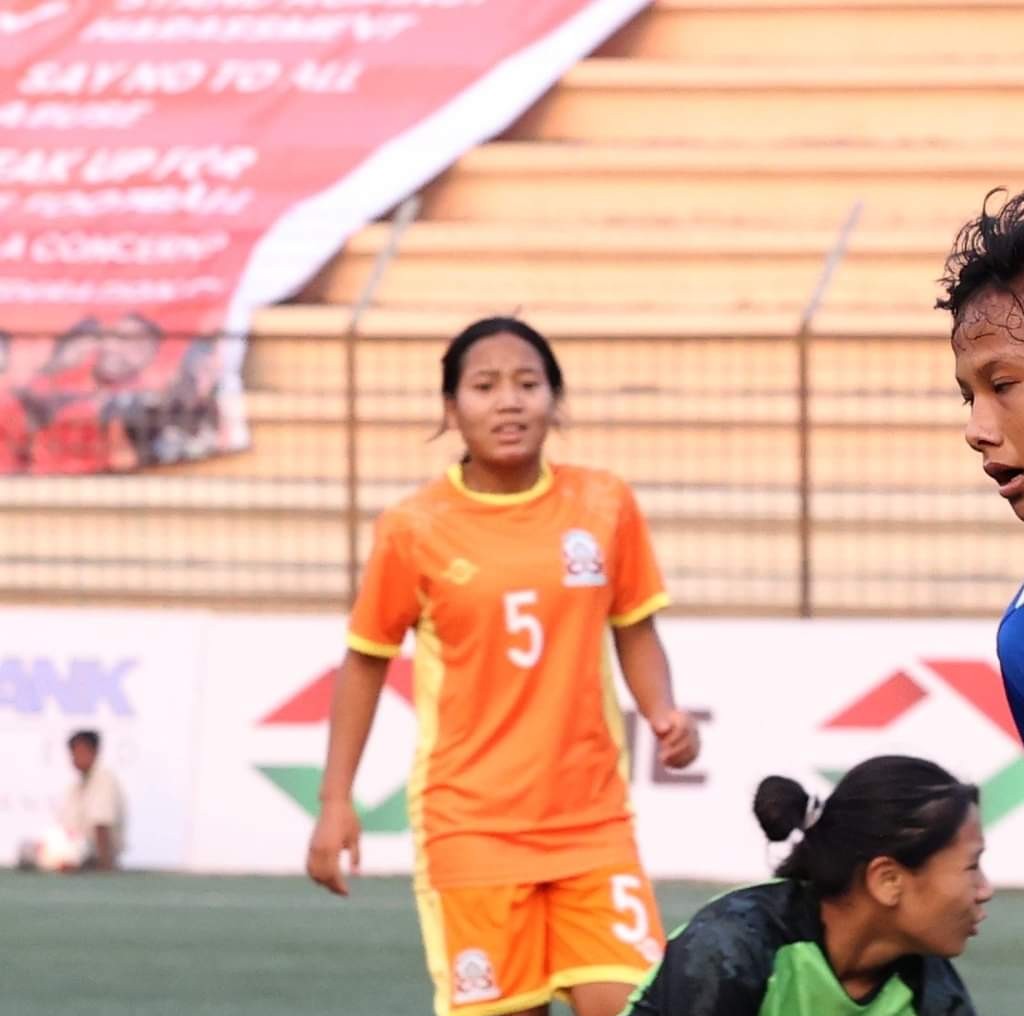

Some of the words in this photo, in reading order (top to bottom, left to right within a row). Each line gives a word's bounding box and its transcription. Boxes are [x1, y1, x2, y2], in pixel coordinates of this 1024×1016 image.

[209, 58, 282, 93] TO
[503, 589, 544, 669] 5
[612, 874, 650, 945] 5
